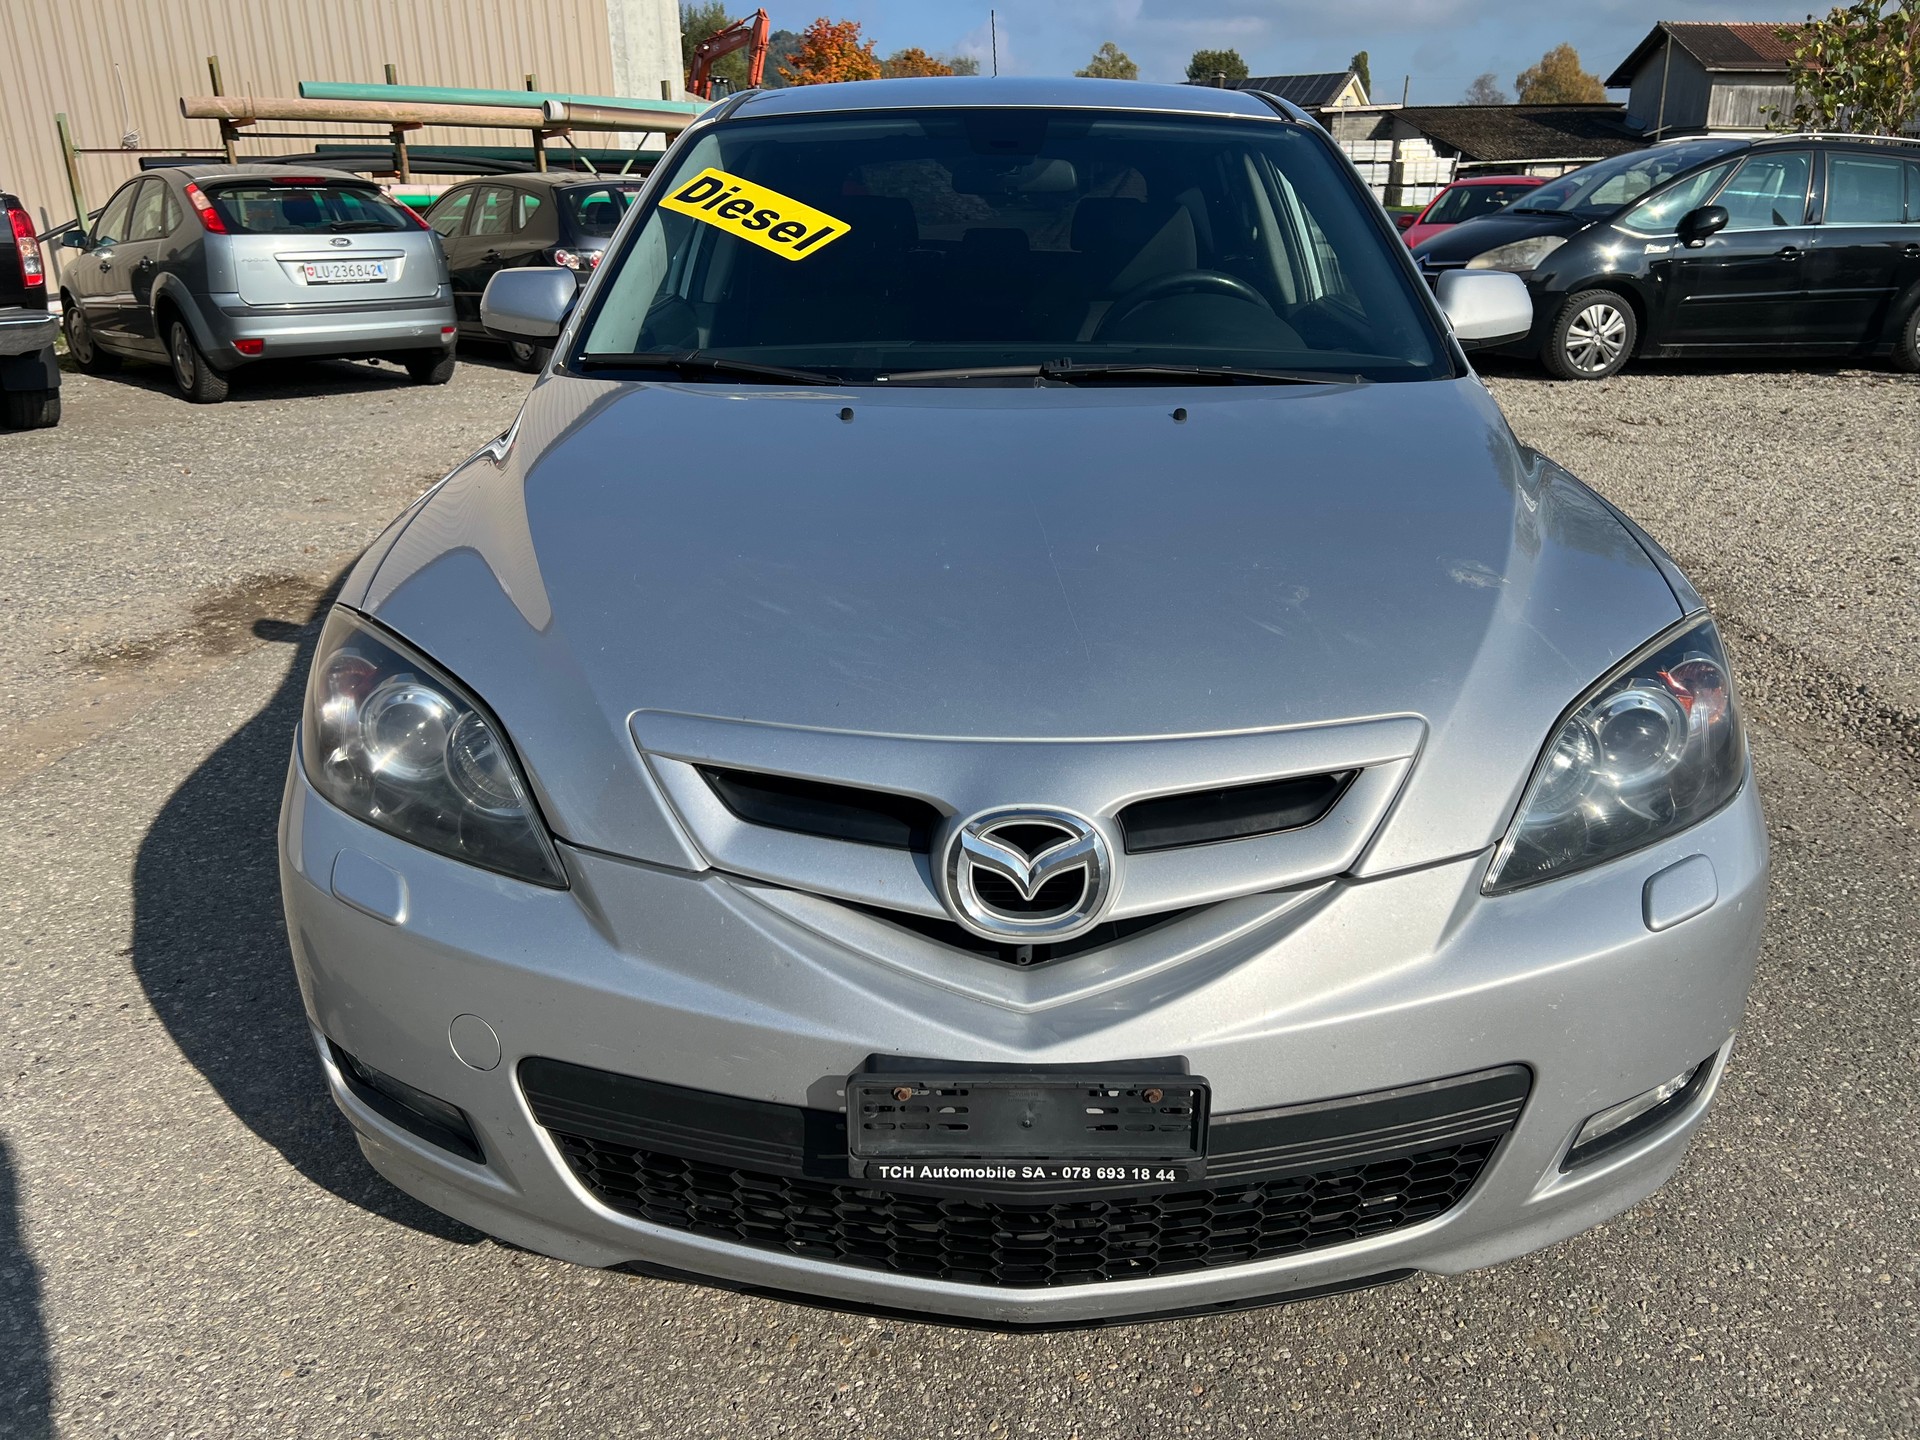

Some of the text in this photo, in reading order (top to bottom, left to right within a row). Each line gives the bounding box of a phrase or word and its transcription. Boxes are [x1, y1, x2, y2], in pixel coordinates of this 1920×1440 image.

[673, 175, 836, 252] Diesel
[879, 1165, 914, 1179] TCH
[919, 1165, 1017, 1179] Automobile
[1021, 1166, 1046, 1179] SA
[1062, 1166, 1091, 1179] 078
[1096, 1167, 1126, 1180] 693
[1130, 1168, 1151, 1180] 18
[1155, 1169, 1176, 1182] 44
